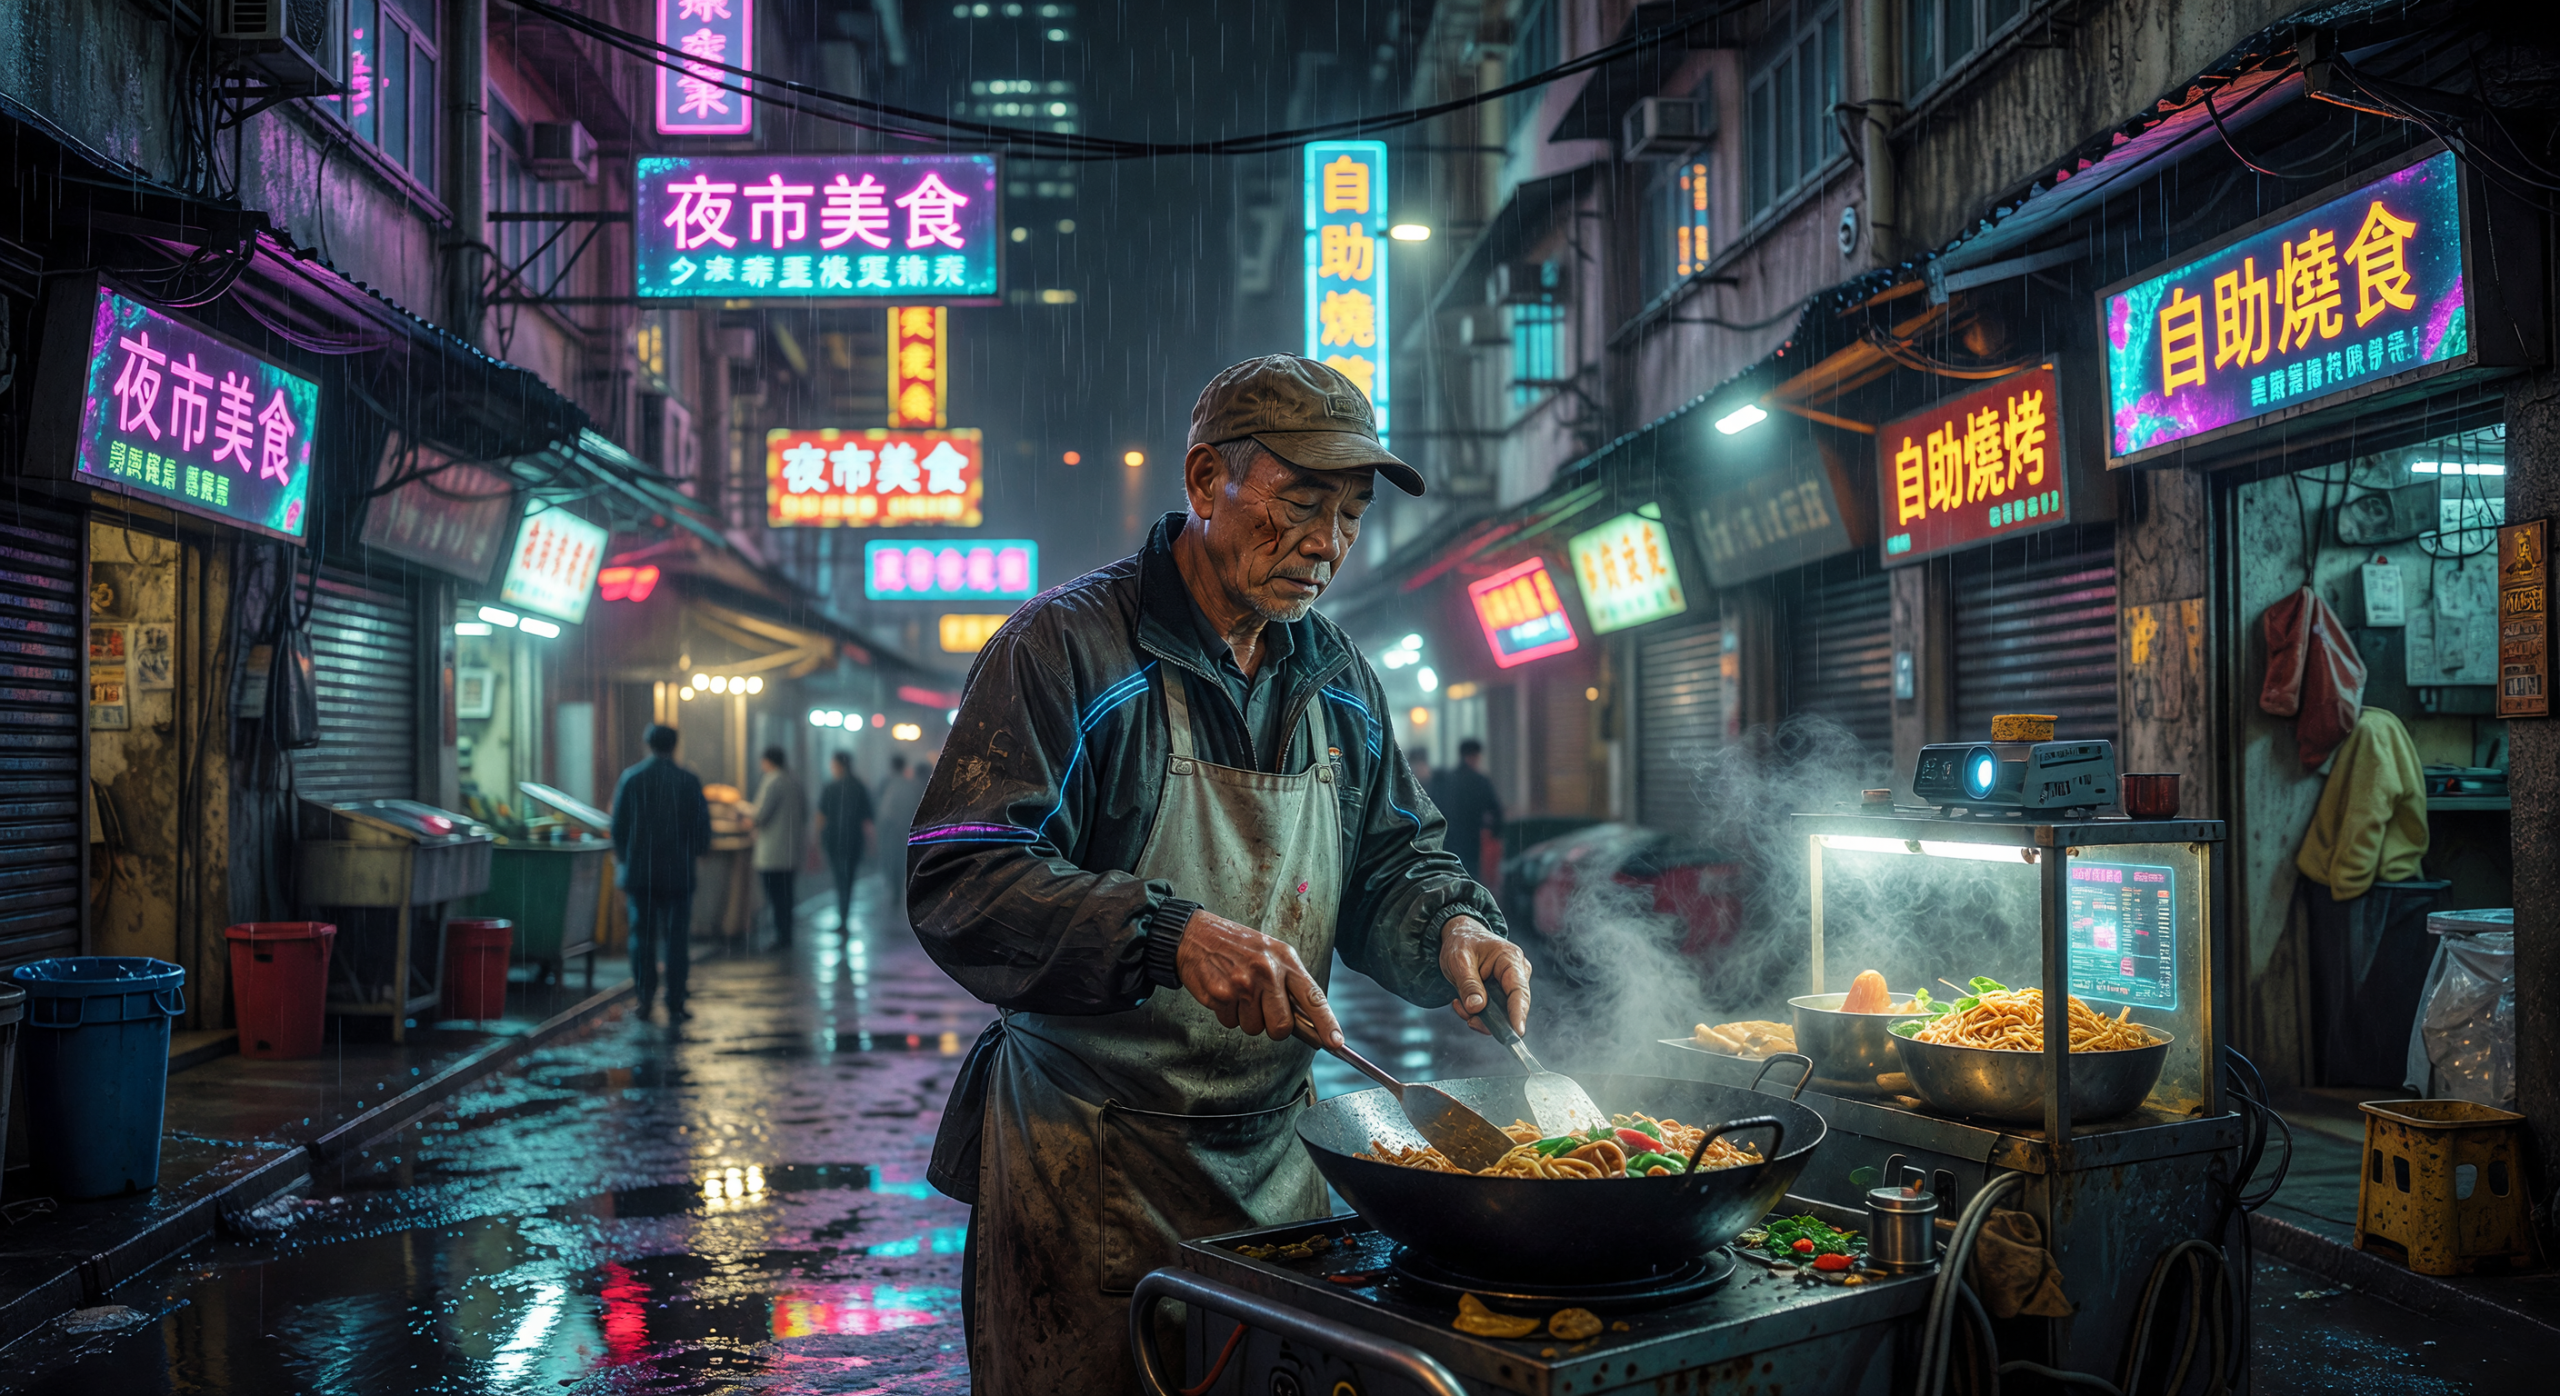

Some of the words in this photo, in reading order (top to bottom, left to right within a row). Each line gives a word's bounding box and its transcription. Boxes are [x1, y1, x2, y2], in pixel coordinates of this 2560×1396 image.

[662, 171, 970, 251] 夜市美食
[2158, 200, 2419, 398] 自助燒食
[113, 331, 296, 487] 夜市美食
[781, 440, 970, 495] 夜市美食
[1894, 389, 2046, 526] 自助燒烤
